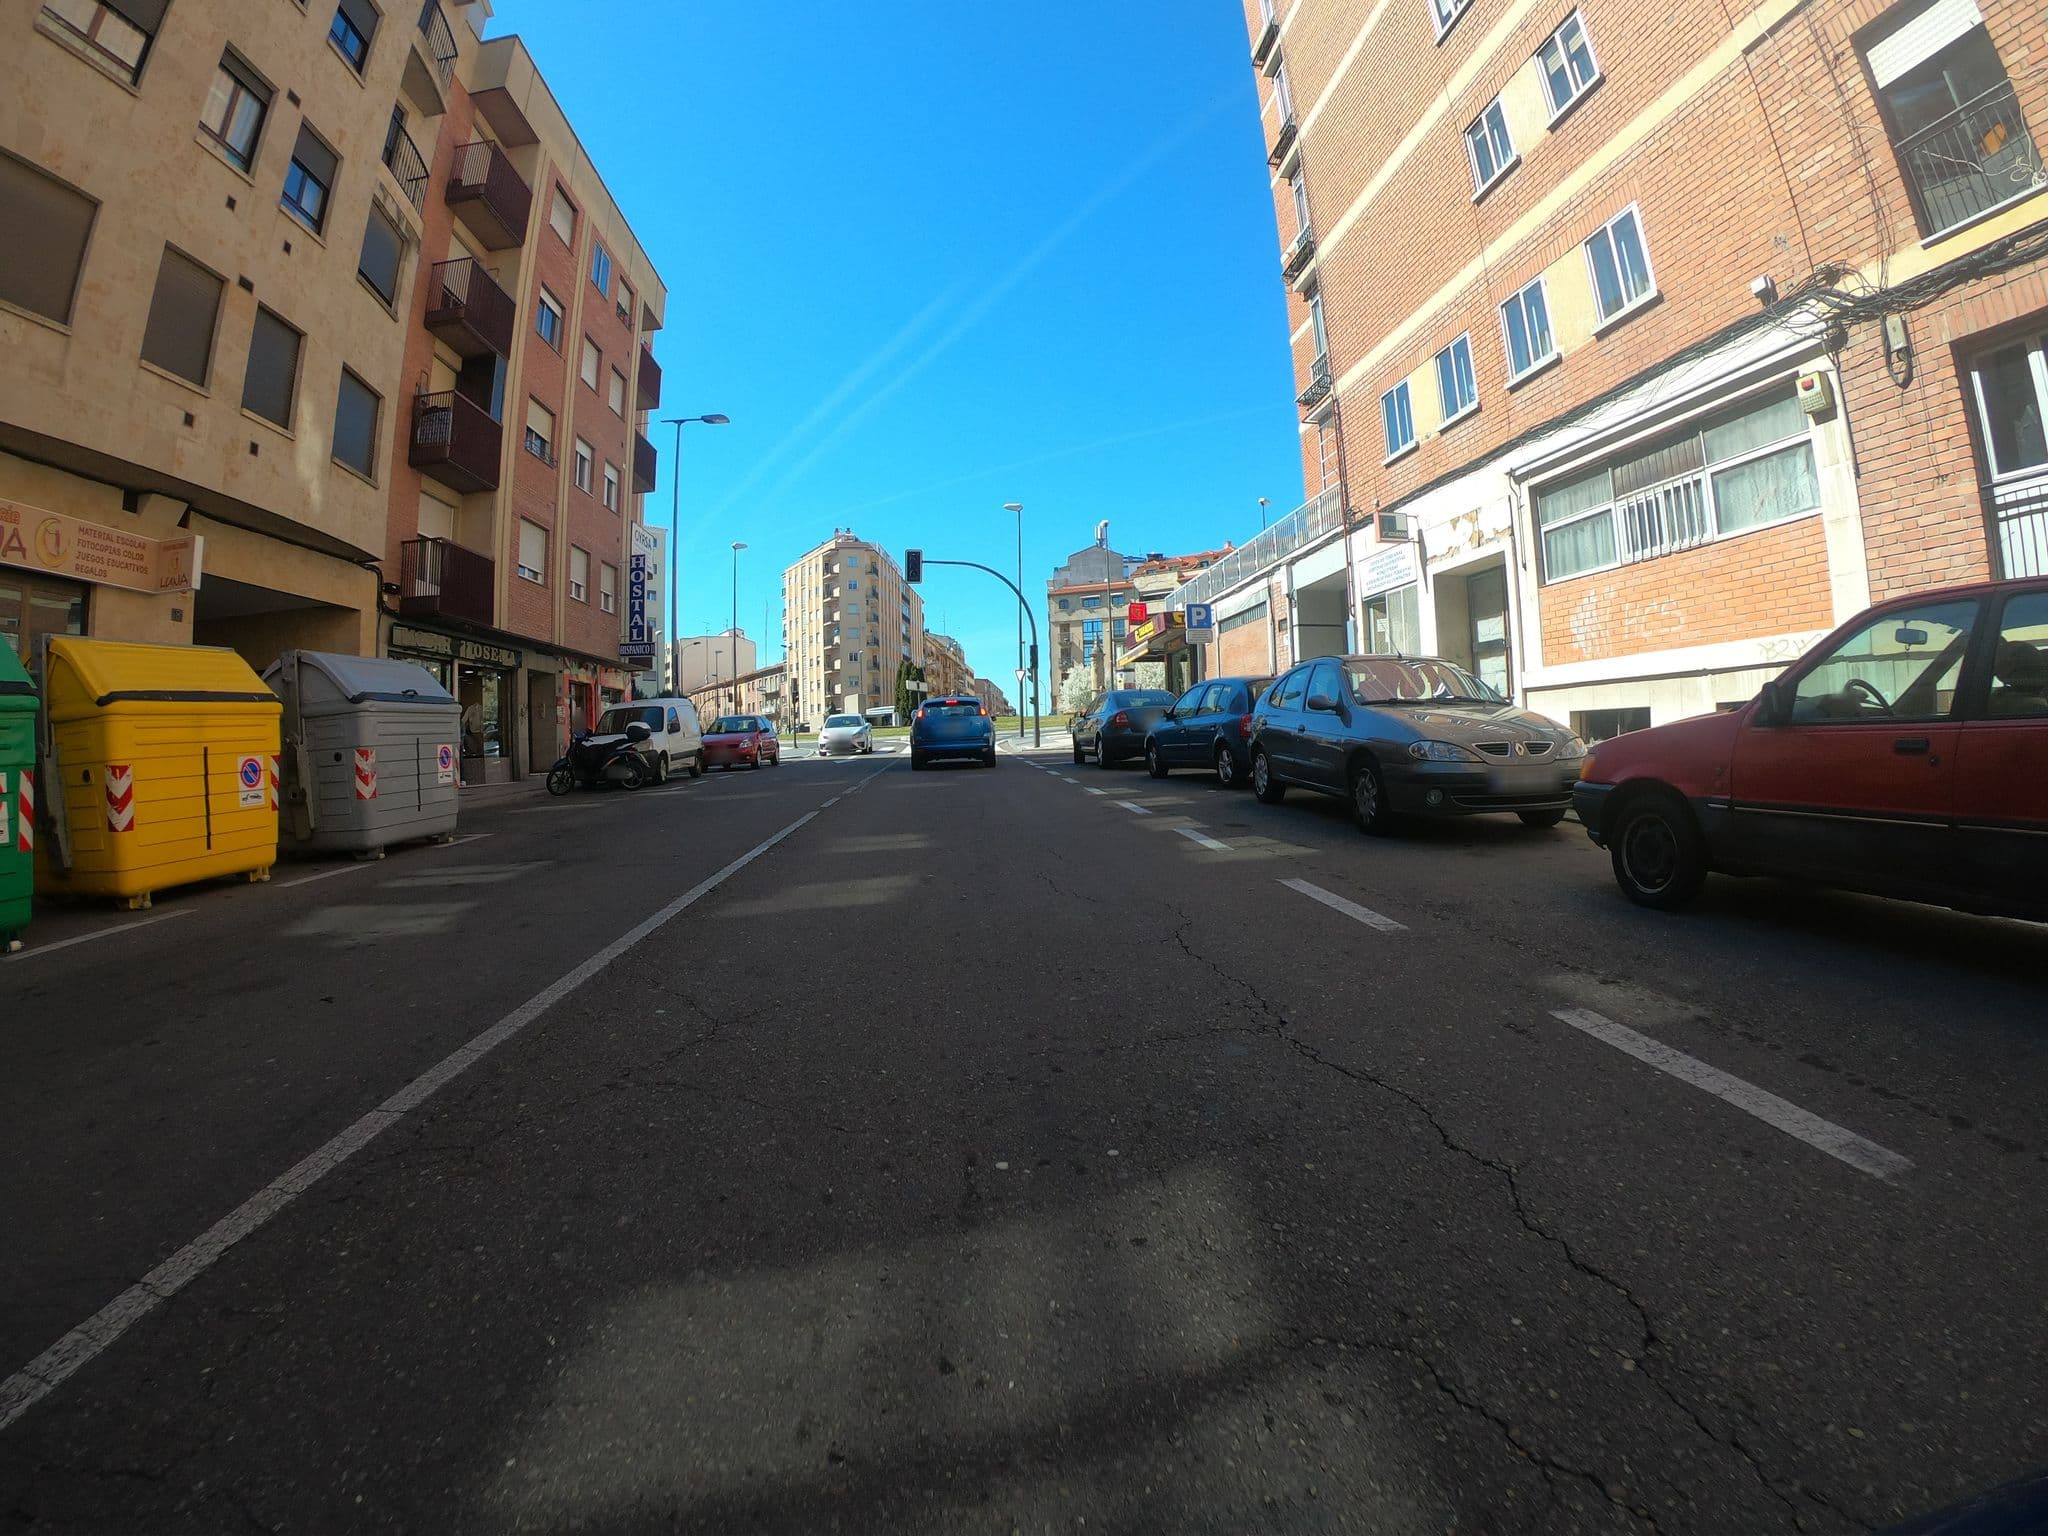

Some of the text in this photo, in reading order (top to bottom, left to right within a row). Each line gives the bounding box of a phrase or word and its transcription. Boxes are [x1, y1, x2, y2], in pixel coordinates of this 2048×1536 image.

[77, 538, 144, 561] FOTOCOPIAS COLOR
[79, 526, 114, 543] MATERIAL
[116, 536, 147, 550] ESCOLAR
[75, 563, 108, 578] REGALOS
[76, 551, 149, 575] JUEGOS EDUCATIVOS
[630, 556, 645, 641] HOSTAL
[1191, 607, 1206, 626] P
[620, 643, 650, 655] HISPANICO
